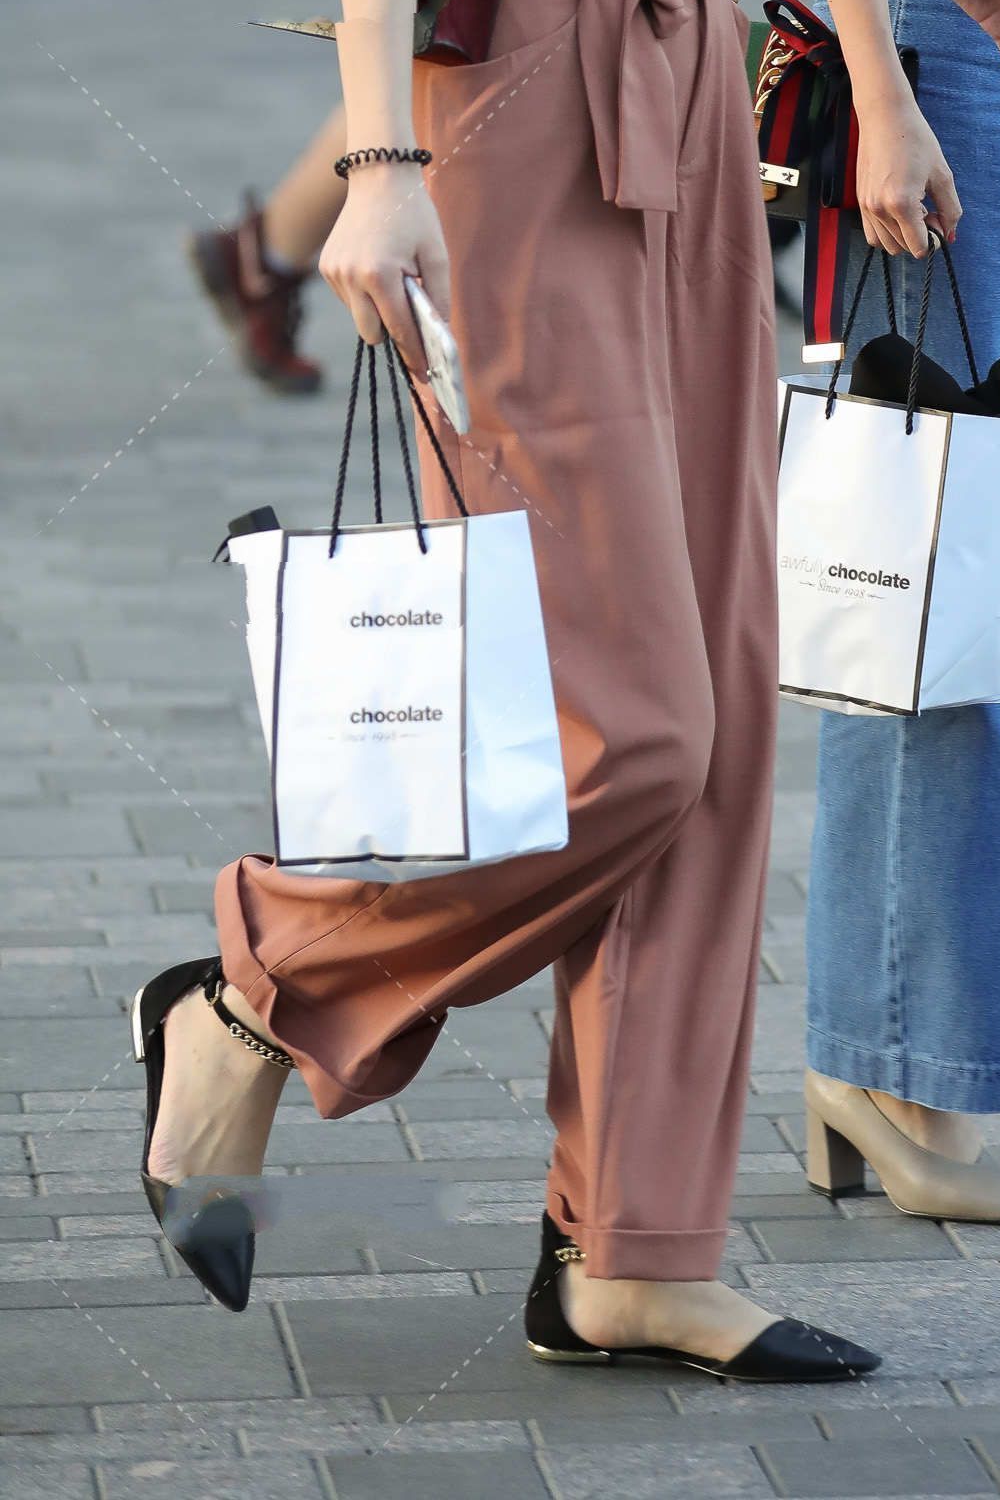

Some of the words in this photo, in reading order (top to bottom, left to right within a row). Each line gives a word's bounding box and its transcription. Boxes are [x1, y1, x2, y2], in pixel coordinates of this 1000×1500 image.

[780, 555, 826, 578] awfully
[828, 563, 910, 589] chocolate
[350, 609, 443, 628] chocolate
[350, 705, 443, 724] chocolate
